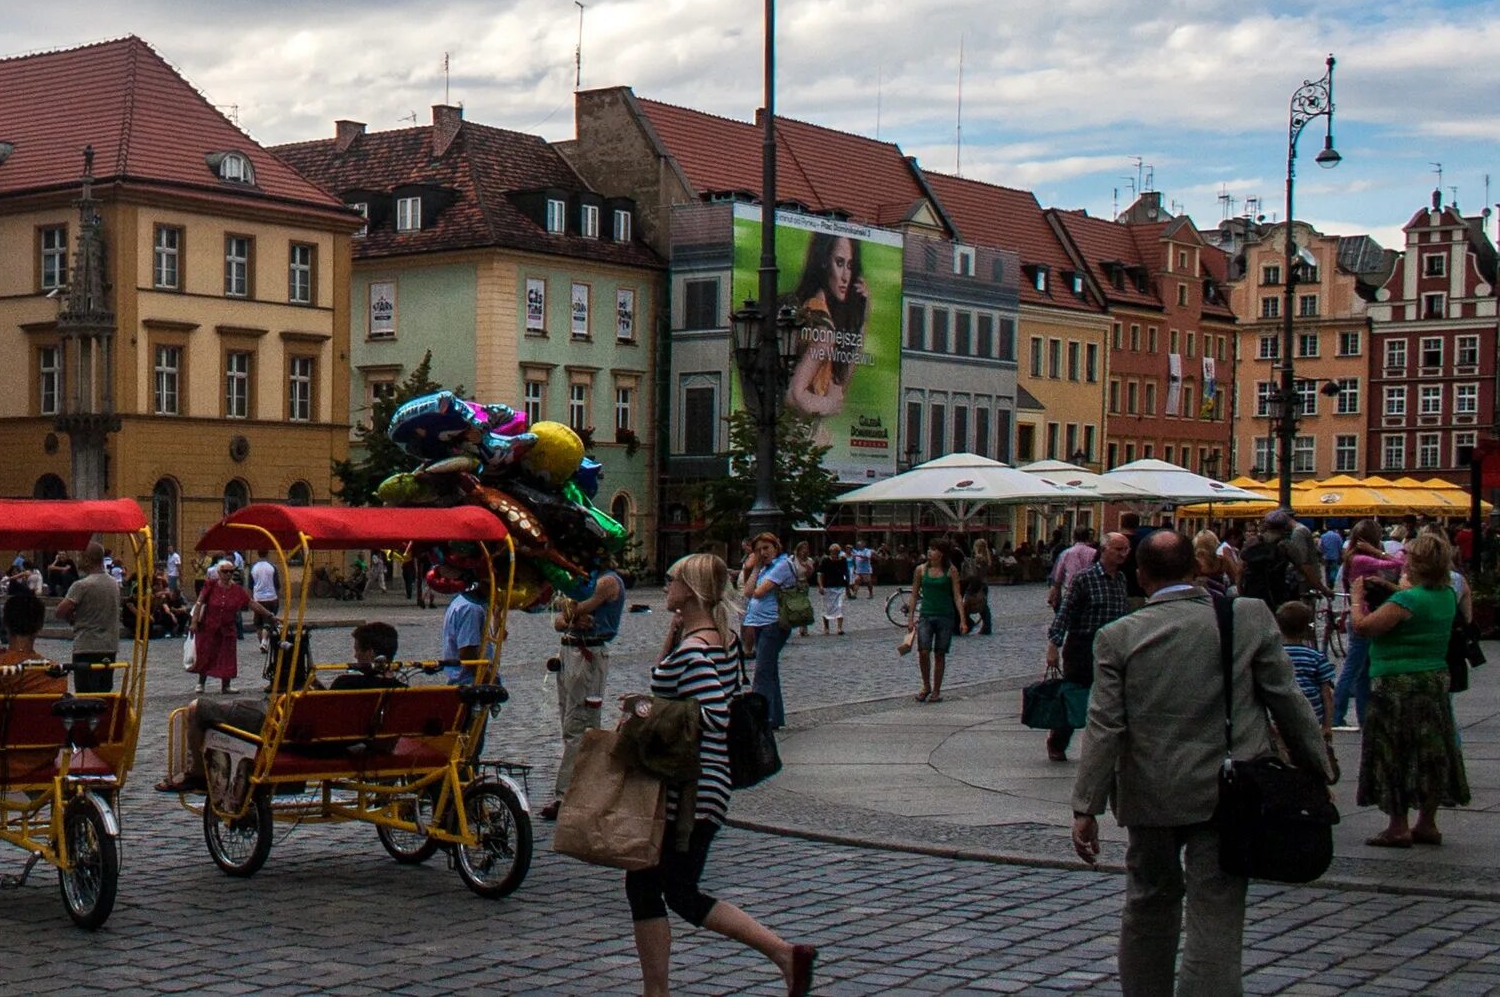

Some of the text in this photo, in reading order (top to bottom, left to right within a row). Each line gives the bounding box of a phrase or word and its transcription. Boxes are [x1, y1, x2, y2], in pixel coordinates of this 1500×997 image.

[800, 326, 864, 349] modniejsza
[810, 346, 875, 366] we Wrocławiu
